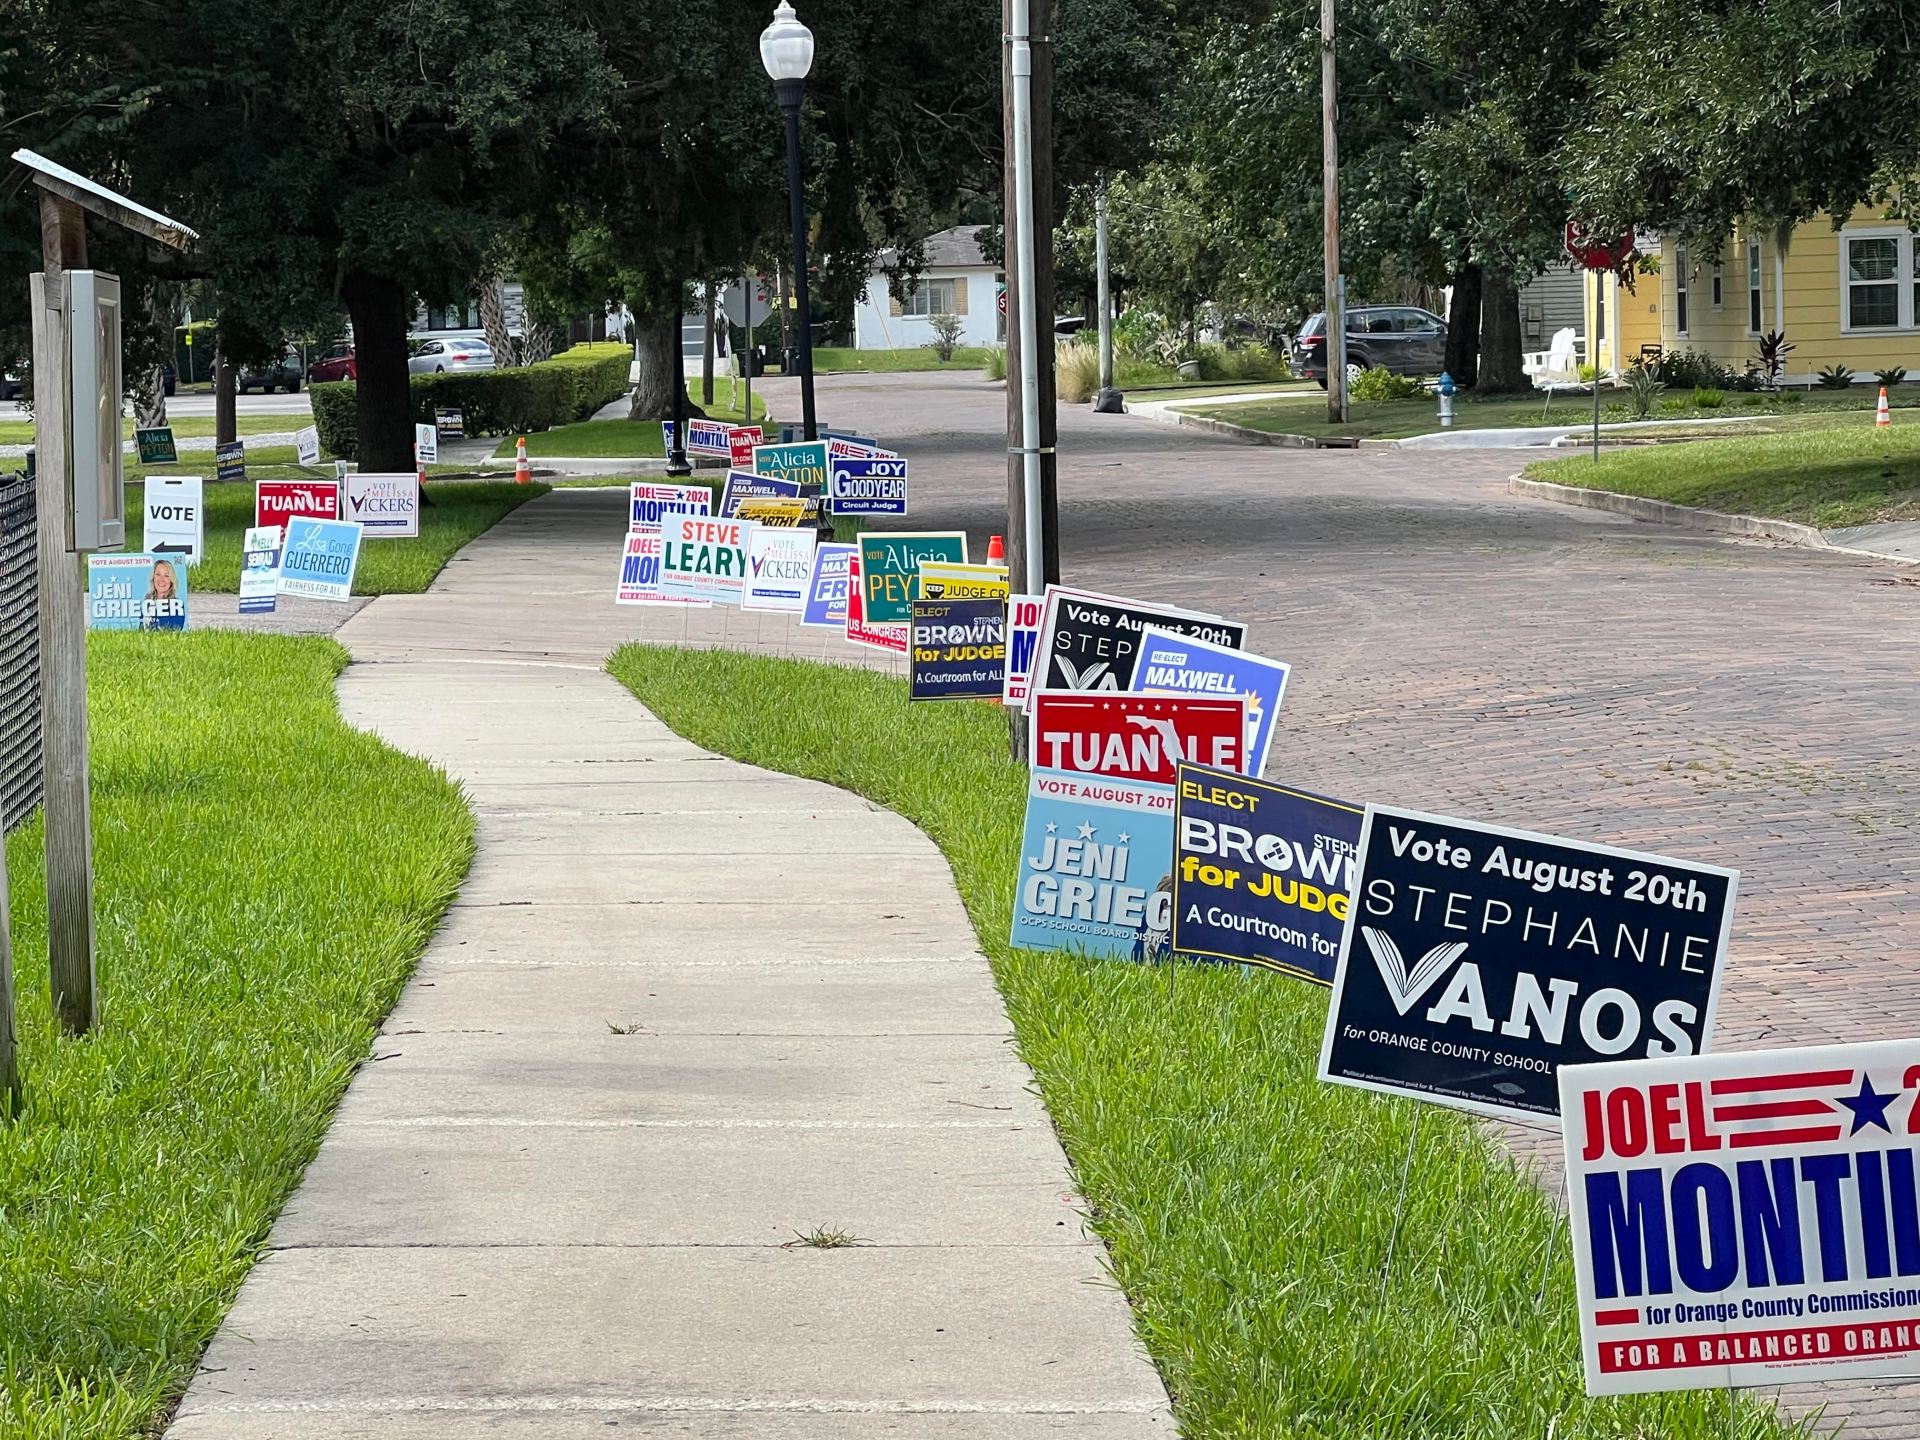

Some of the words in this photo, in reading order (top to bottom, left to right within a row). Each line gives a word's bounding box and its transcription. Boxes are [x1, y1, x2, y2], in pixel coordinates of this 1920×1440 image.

[690, 421, 704, 429] JOEL
[145, 433, 169, 444] Alicia
[731, 437, 750, 446] TUAN
[751, 435, 762, 445] LE
[830, 442, 850, 455] JOEL
[217, 449, 243, 462] BROWN
[771, 451, 816, 470] Alicia
[866, 462, 905, 476] JOY
[732, 485, 777, 495] MAXWELL
[834, 470, 905, 498] GOODYEAR
[261, 496, 306, 511] TUAN
[315, 496, 335, 511] LE
[350, 496, 414, 513] VICKERS
[634, 487, 656, 499] JOEL
[686, 490, 709, 503] 2024
[150, 506, 194, 521] VOTE
[871, 502, 898, 510] Judge
[257, 536, 274, 549] KELLY
[296, 525, 327, 553] Lisa
[329, 540, 353, 556] Gong
[682, 521, 740, 545] STEVE
[627, 539, 653, 554] JOEL
[771, 550, 809, 560] MELISSA
[773, 540, 795, 550] VOTE
[285, 551, 351, 575] GUERRERO
[664, 541, 747, 578] LEARY
[751, 555, 809, 579] VICKERS
[866, 551, 885, 560] VOTE
[884, 545, 948, 575] Alicia
[93, 583, 132, 600] JENI
[285, 580, 315, 592] FAIRNESS
[315, 582, 328, 593] FOR
[329, 583, 341, 595] ALL
[947, 586, 986, 598] JUDGE
[93, 599, 185, 619] GRIEGER
[828, 601, 846, 609] FOR
[915, 607, 951, 617] ELECT
[1014, 602, 1043, 627] JO
[849, 619, 860, 631] US
[861, 626, 907, 642] CONGRESS
[973, 617, 1003, 625] STEPHEN
[1067, 604, 1111, 625] Vote
[1188, 625, 1233, 647] 20th
[914, 624, 1004, 645] BROWN
[915, 647, 940, 662] for
[943, 645, 1005, 661] JUDGE
[1153, 654, 1184, 664] RE-ELECT
[916, 673, 923, 683] A
[925, 672, 971, 683] Courtroom
[973, 670, 987, 681] for
[988, 670, 1004, 680] ALL
[1144, 666, 1236, 693] MAXWELL
[1043, 732, 1159, 772] TUAN
[1187, 735, 1236, 773] LE
[1038, 779, 1077, 796] VOTE
[1081, 787, 1143, 805] AUGUST
[1182, 780, 1260, 813] ELECT
[1028, 835, 1129, 882] JENI
[1181, 856, 1240, 890] for
[1388, 825, 1472, 870] Vote
[1481, 846, 1614, 896] August
[1623, 870, 1707, 913] 20th
[1049, 920, 1091, 934] SCHOOL
[1094, 927, 1130, 940] BOARD
[1185, 903, 1202, 924] A
[1207, 907, 1307, 950] Courtroom
[1311, 932, 1338, 957] for
[1364, 879, 1709, 974] STEPHANIE
[1361, 924, 1699, 1057] VANOS
[1343, 1024, 1366, 1042] for
[1369, 1030, 1428, 1052] ORANGE
[1431, 1040, 1490, 1063] COUNTY
[1493, 1052, 1552, 1075] SCHOOL
[1342, 1069, 1365, 1078] Political
[1365, 1073, 1405, 1086] advertisement
[1405, 1081, 1419, 1089] paid
[1434, 1085, 1462, 1097] approved
[1461, 1090, 1470, 1098] by
[1470, 1092, 1498, 1103] Stephanie
[1582, 1081, 1722, 1162] JOEL
[1646, 1305, 1672, 1326] for
[1674, 1301, 1738, 1323] Orange
[1742, 1296, 1804, 1319] County
[1807, 1288, 1920, 1314] Commission
[1614, 1344, 1660, 1367] FOR
[1673, 1342, 1687, 1362] A
[1699, 1332, 1831, 1361] BALANCED
